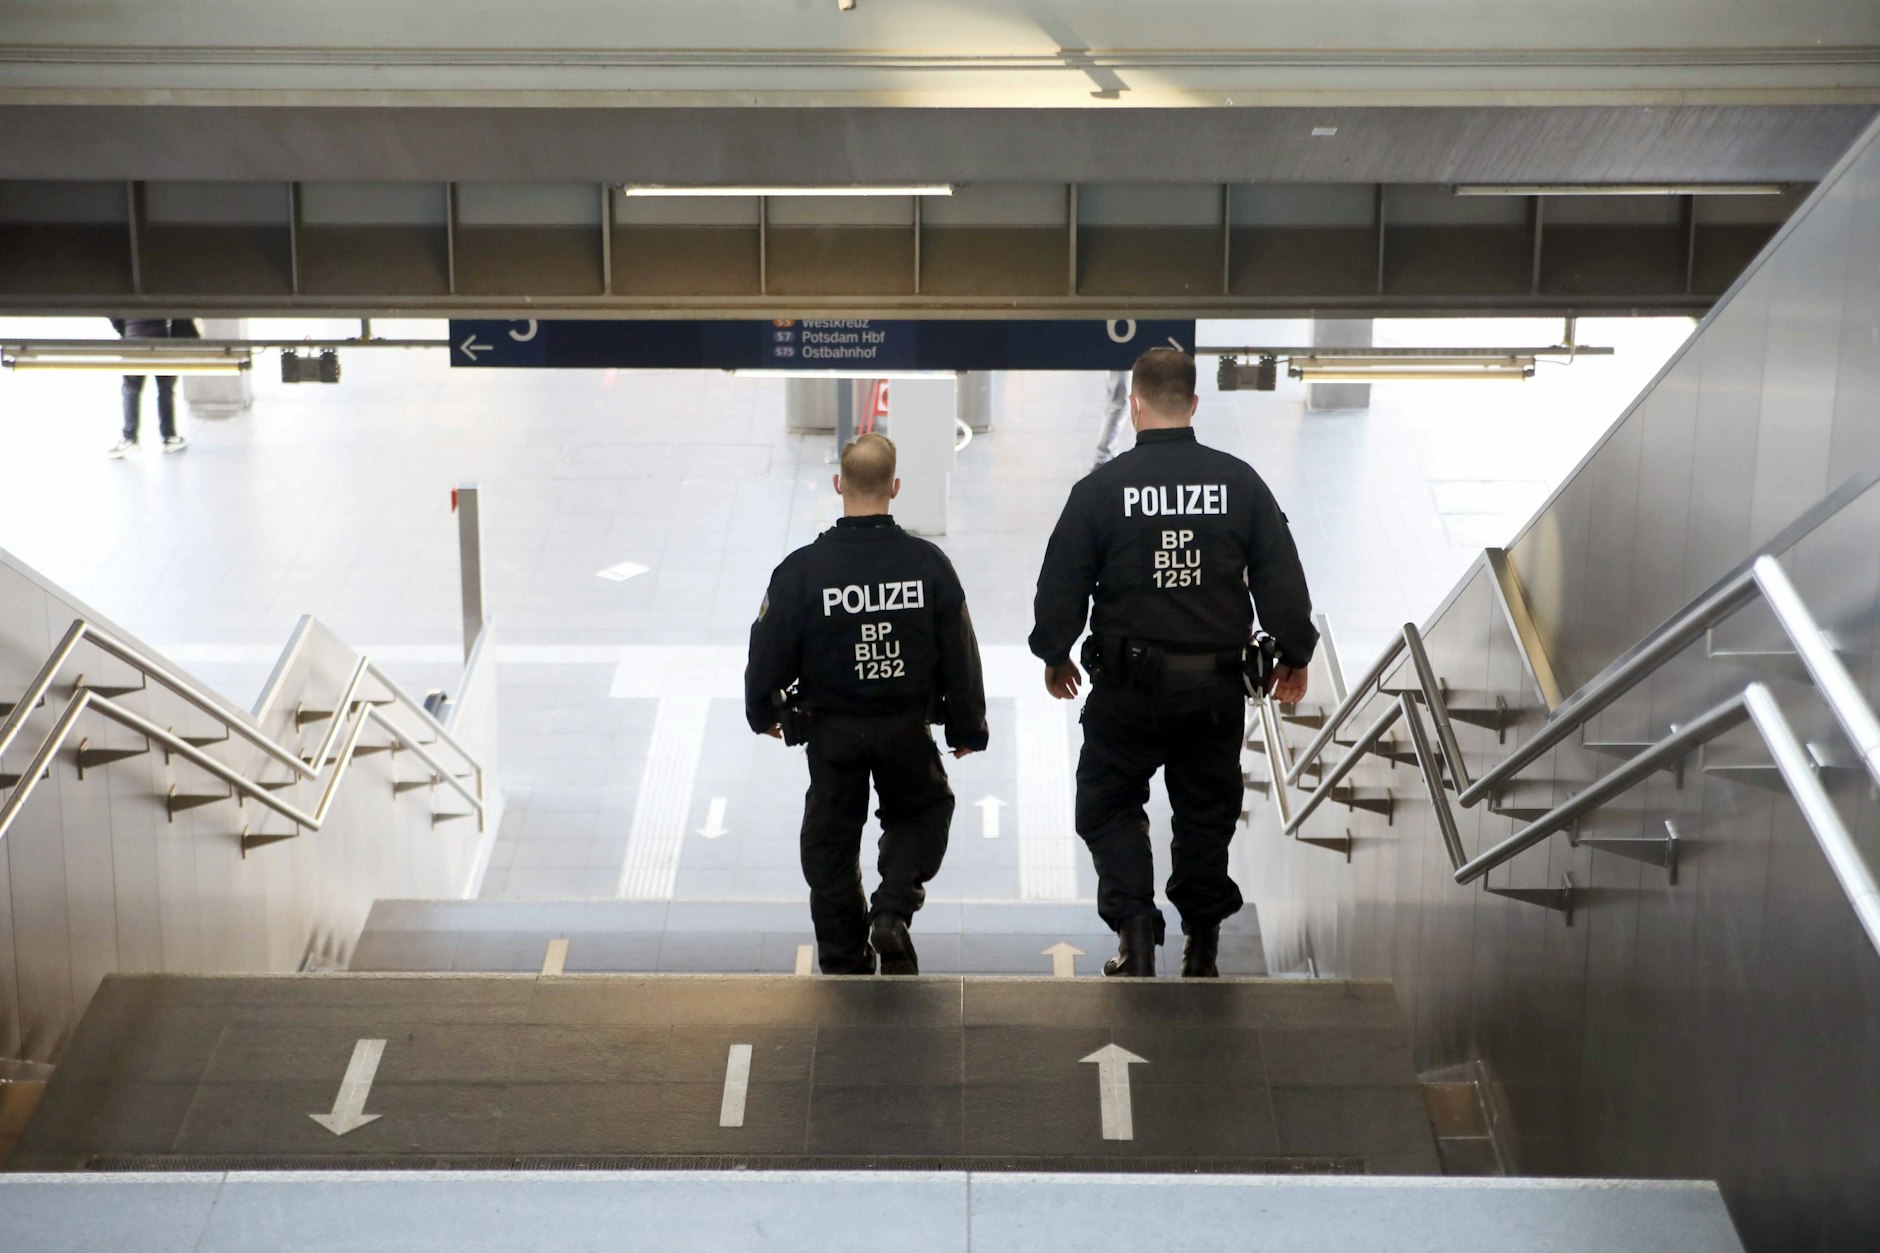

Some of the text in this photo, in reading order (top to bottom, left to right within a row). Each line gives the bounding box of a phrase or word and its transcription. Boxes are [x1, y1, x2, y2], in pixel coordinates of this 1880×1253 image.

[776, 331, 885, 343] S7 Potsdam Hbf
[802, 346, 877, 358] Ostbahnhof
[1123, 484, 1228, 517] POLIZEI
[1161, 530, 1194, 549] BP
[1154, 549, 1201, 569] BLU
[1152, 569, 1202, 589] 1251
[822, 580, 925, 617] POLIZEI
[861, 622, 893, 642] BP
[855, 640, 901, 662] BLU
[854, 659, 906, 680] 1252
